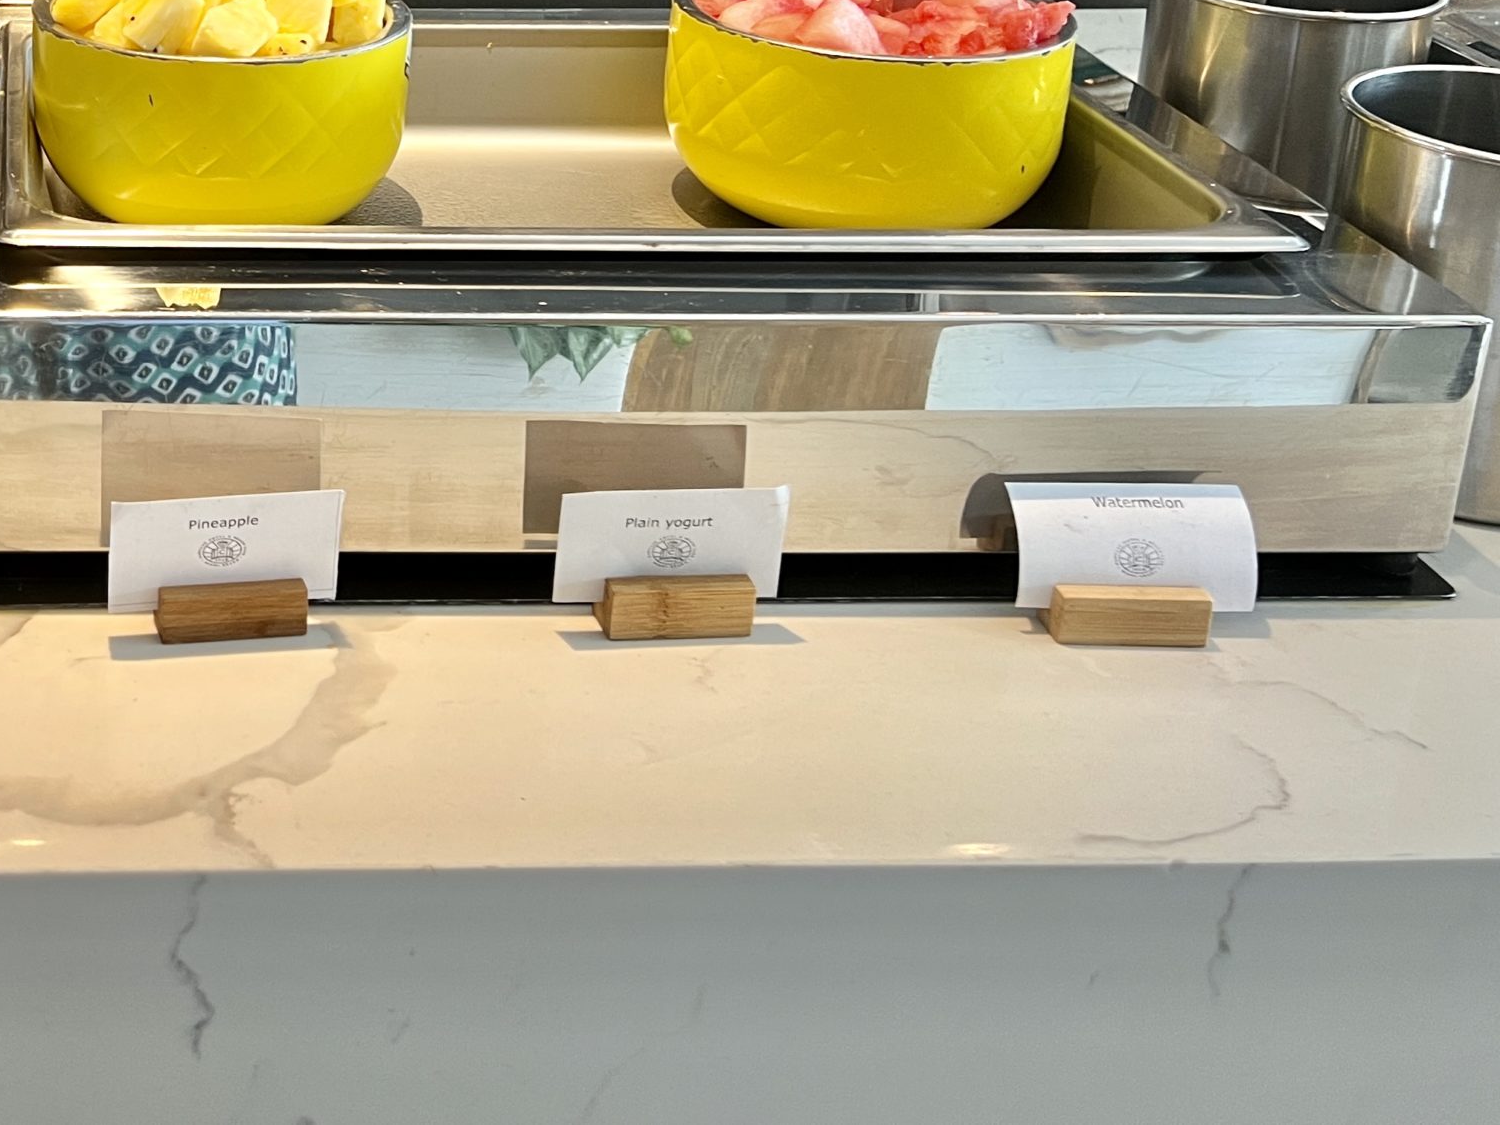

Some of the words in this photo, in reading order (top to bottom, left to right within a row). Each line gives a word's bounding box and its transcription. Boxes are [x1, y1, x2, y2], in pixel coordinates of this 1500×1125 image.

[1090, 495, 1185, 510] Watermelon
[188, 515, 259, 530] Pineapple
[625, 516, 660, 529] Plain
[666, 516, 713, 531] yogurt
